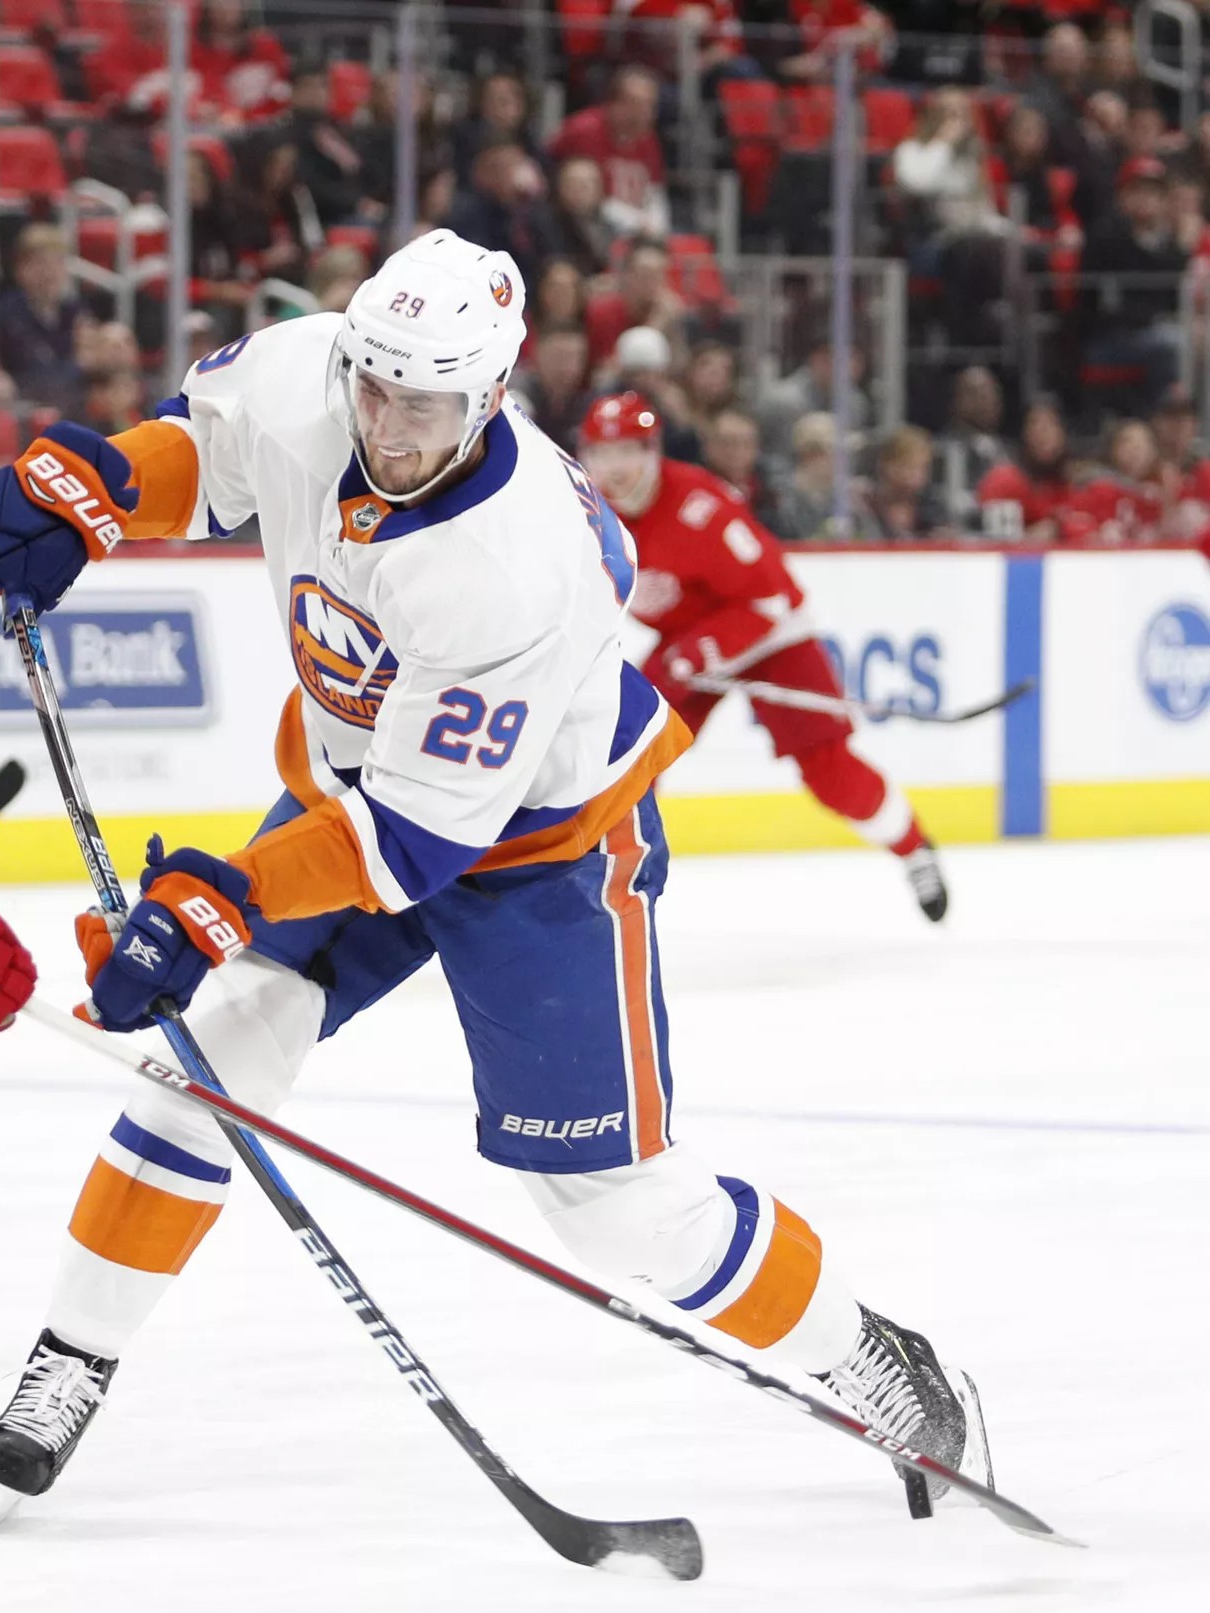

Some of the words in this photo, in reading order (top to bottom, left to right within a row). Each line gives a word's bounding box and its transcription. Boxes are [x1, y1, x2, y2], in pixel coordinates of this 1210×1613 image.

[389, 291, 425, 319] 29
[420, 686, 530, 769] 29
[140, 1059, 191, 1091] CM
